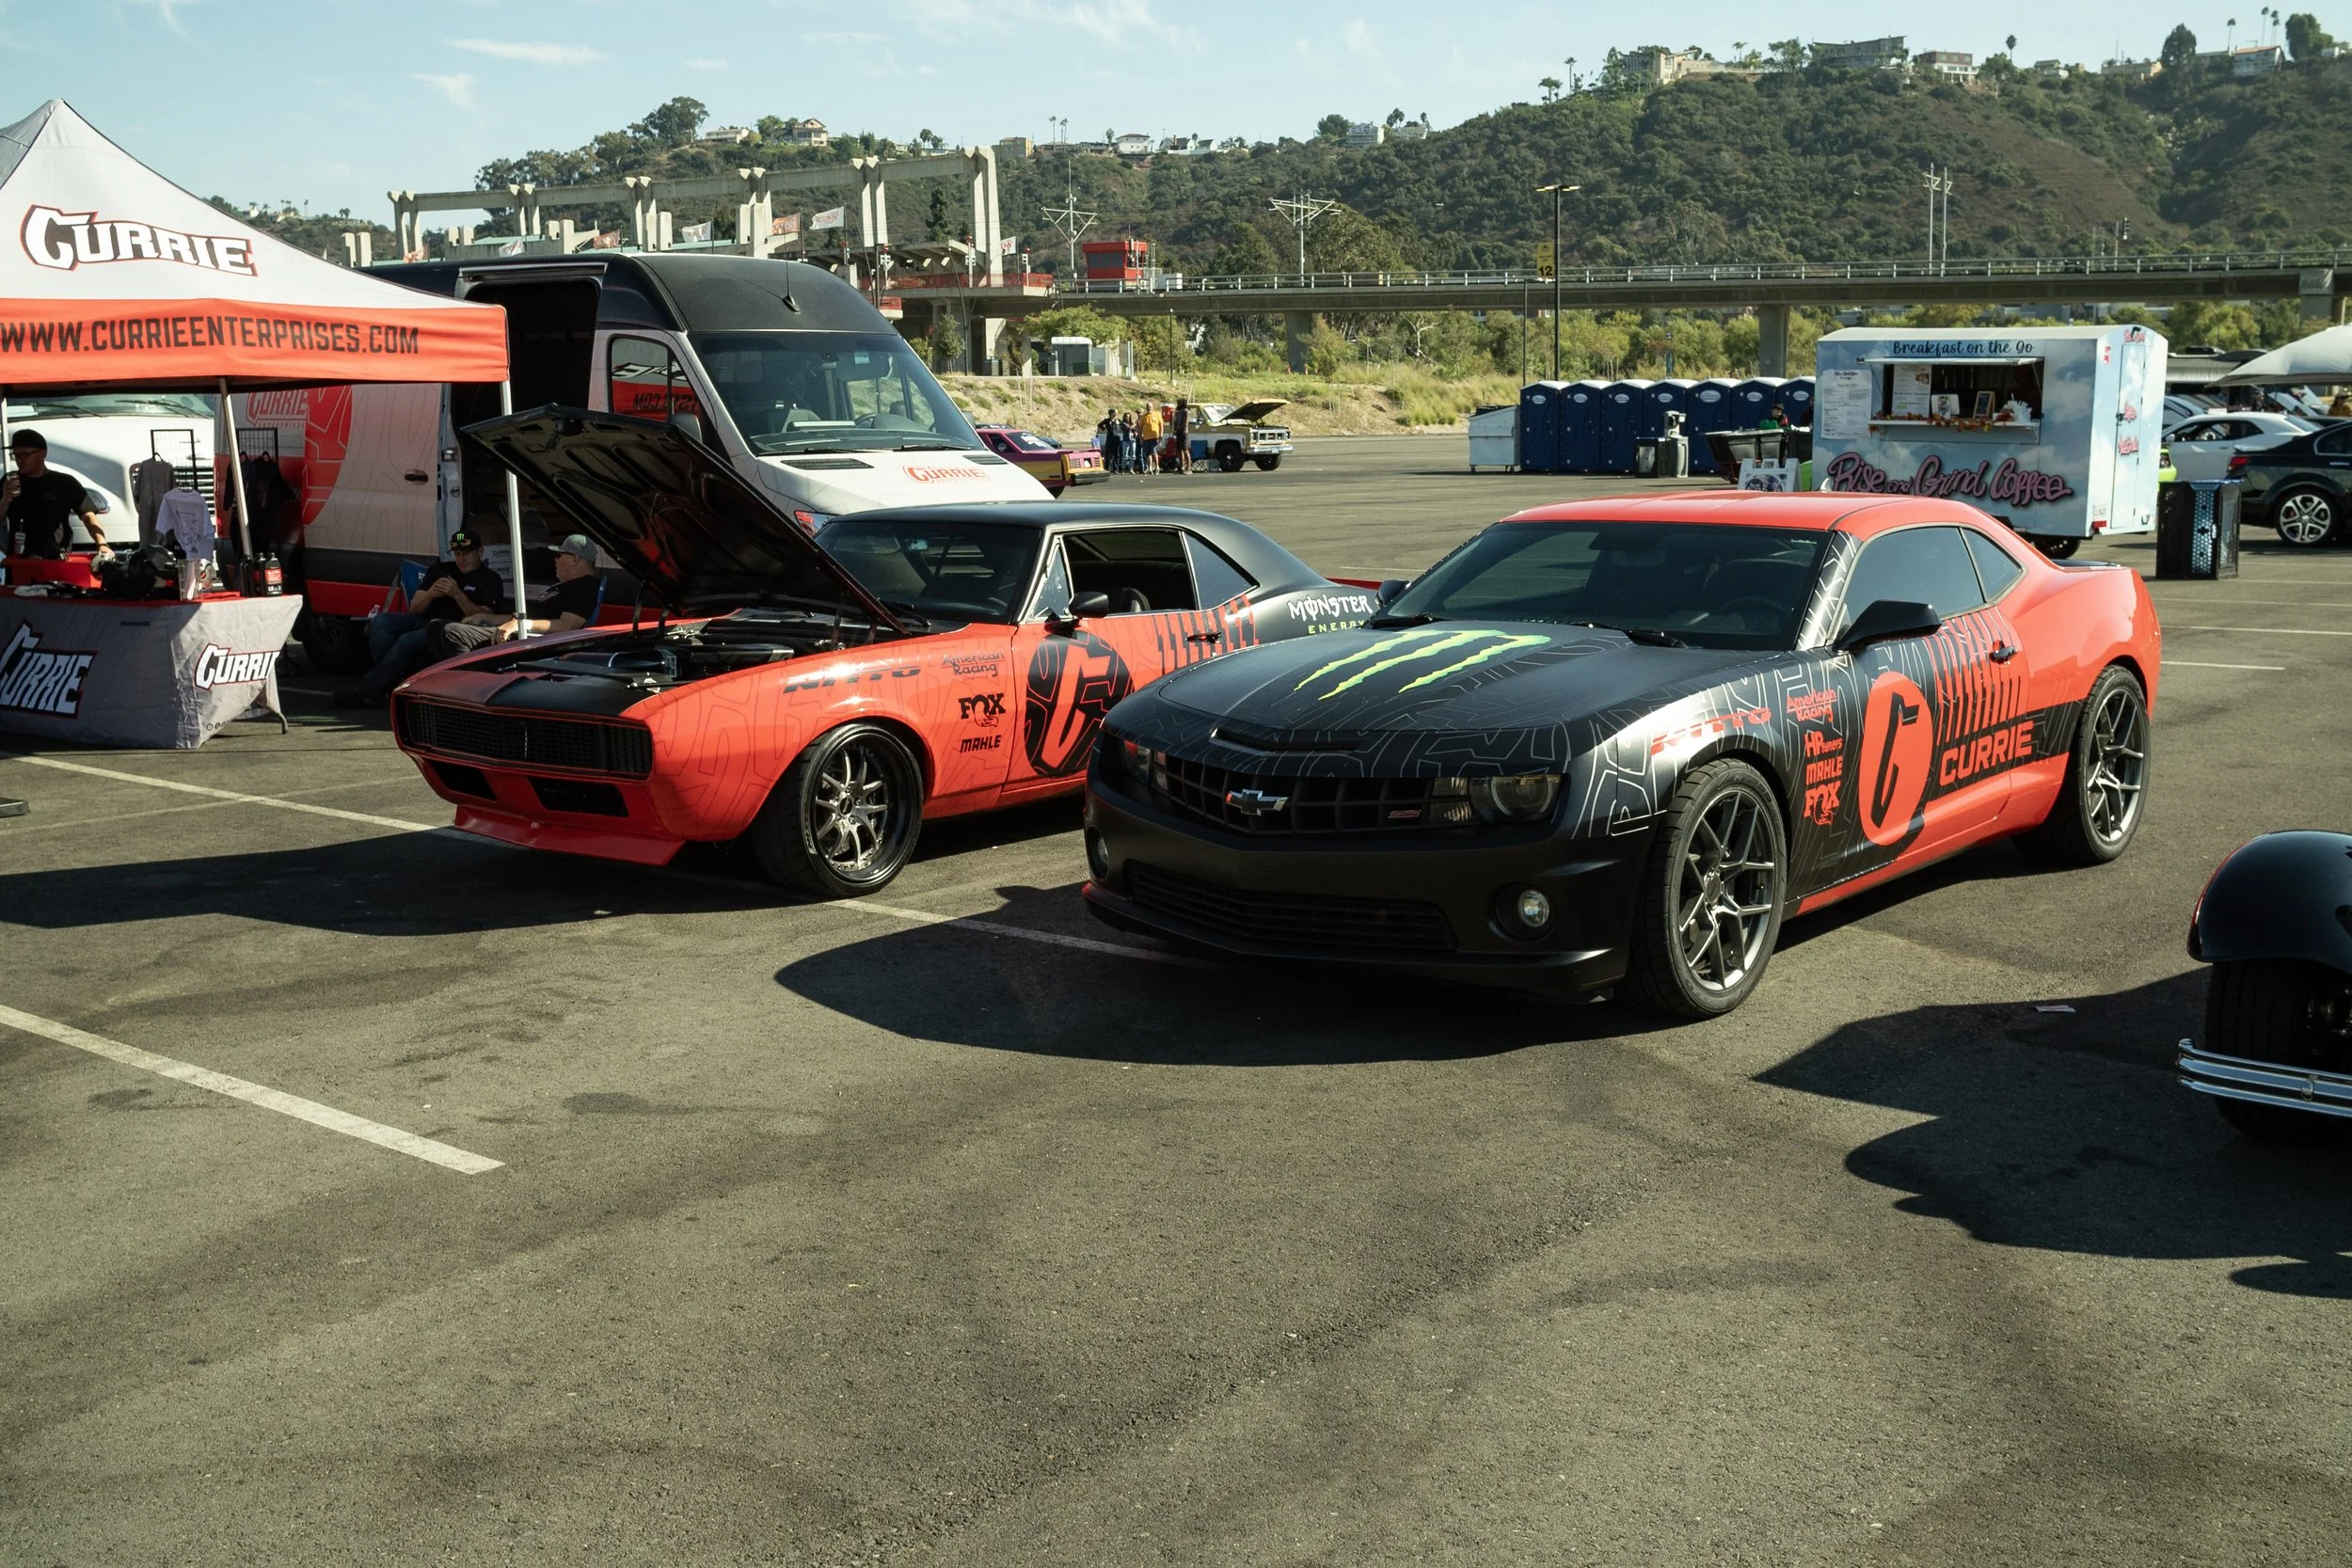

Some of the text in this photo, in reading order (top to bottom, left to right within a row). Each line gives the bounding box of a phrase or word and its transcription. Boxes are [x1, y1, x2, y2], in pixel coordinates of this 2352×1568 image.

[23, 205, 256, 277] CURRIE
[1538, 265, 1553, 277] 12
[1, 315, 421, 355] WWW.CURRIEENTERPRISES.COM
[1893, 341, 1964, 357] Breakfast
[1966, 344, 1984, 355] on
[1987, 340, 2011, 355] the
[906, 467, 988, 482] CURRIE
[1828, 451, 1886, 492] Rise
[1914, 454, 1989, 499] Grind
[1989, 457, 2074, 507] Coffee
[0, 621, 95, 715] CURRIE
[942, 652, 1005, 667] American
[953, 662, 999, 677] Racing
[958, 692, 1007, 727] FOX
[1787, 688, 1837, 712] American
[1796, 703, 1834, 722] Racing
[960, 735, 1002, 753] MAHLE
[1939, 721, 2034, 786] CURRIE
[1805, 756, 1844, 784] MAHLE
[1804, 781, 1841, 822] FOX
